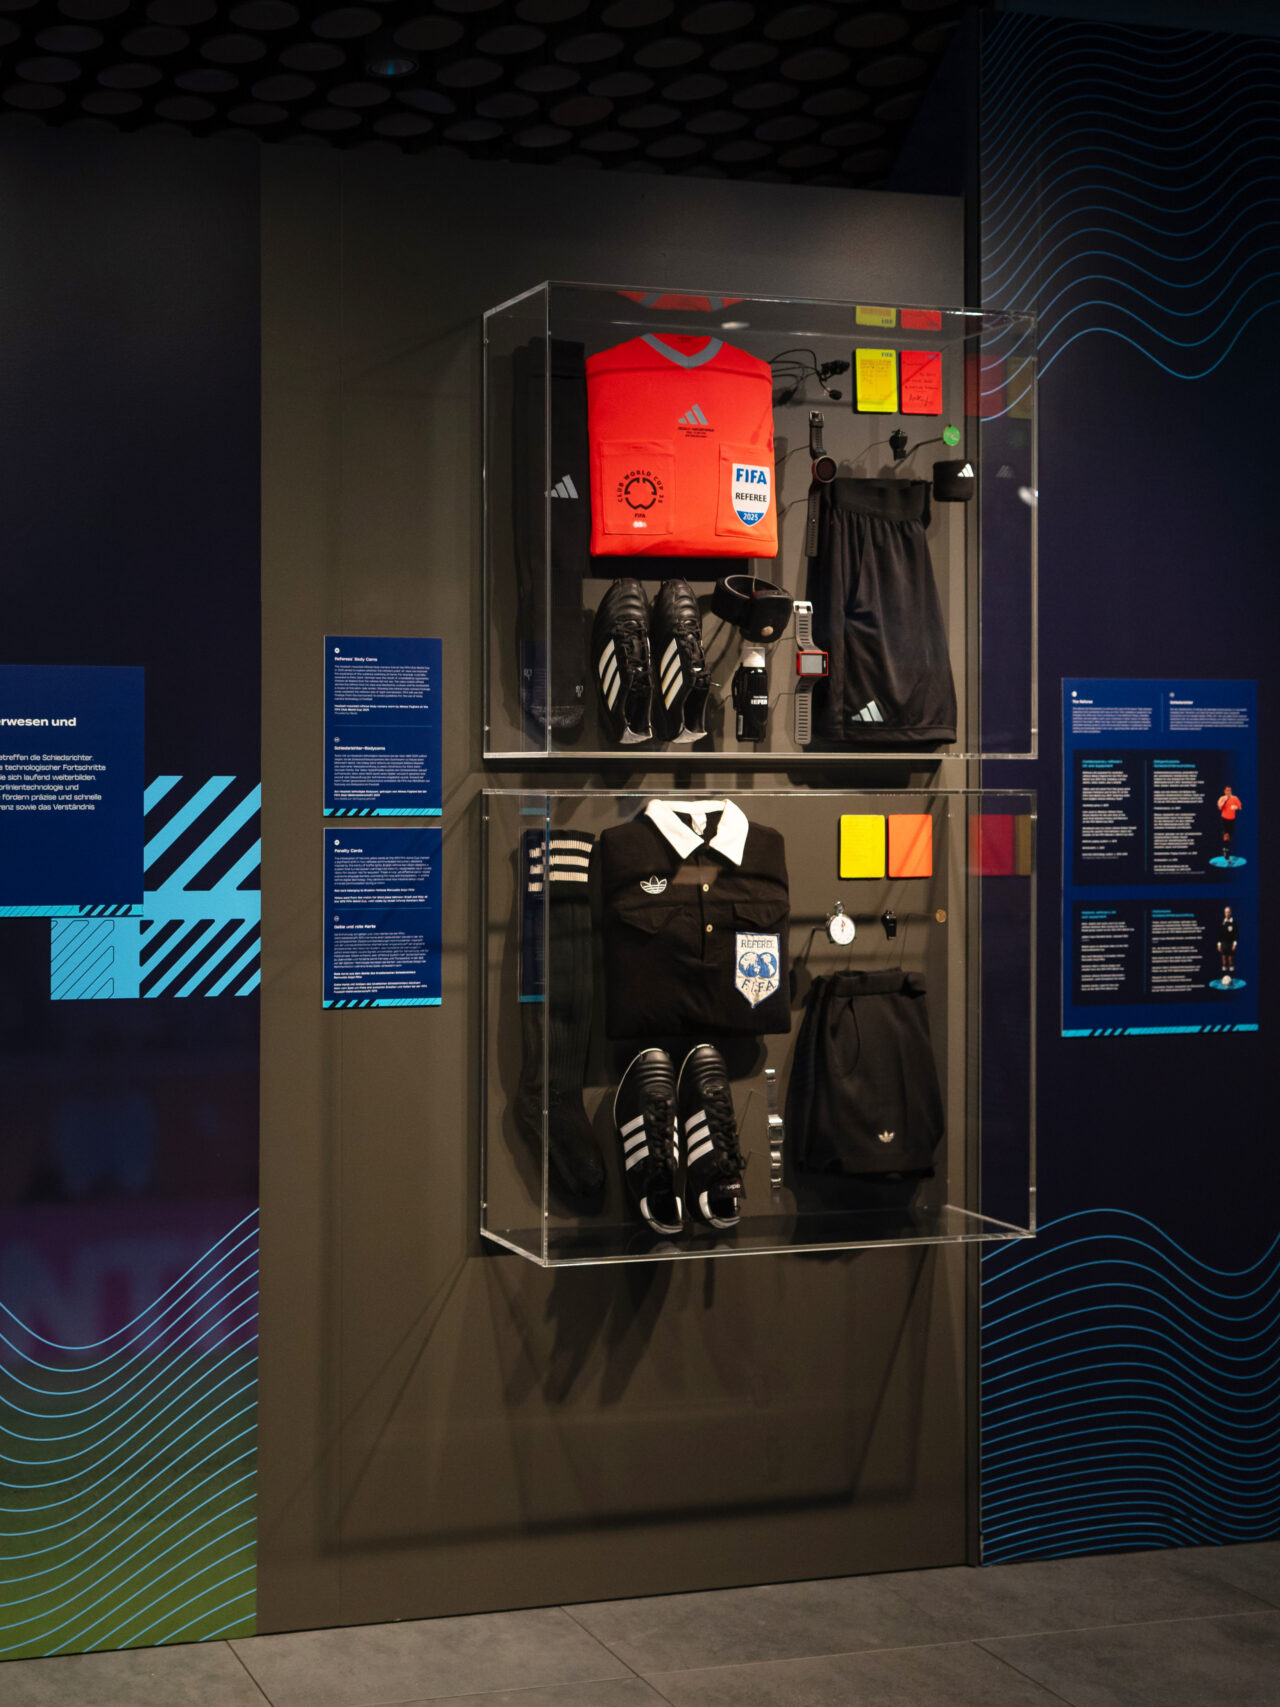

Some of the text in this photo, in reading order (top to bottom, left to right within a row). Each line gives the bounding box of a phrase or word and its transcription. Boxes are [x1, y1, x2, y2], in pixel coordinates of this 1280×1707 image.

[736, 468, 767, 484] FIFA
[735, 492, 767, 502] REFEREE
[742, 512, 758, 521] 2025
[51, 717, 76, 726] und
[5, 764, 61, 772] technologischer
[741, 939, 775, 949] REFEREE
